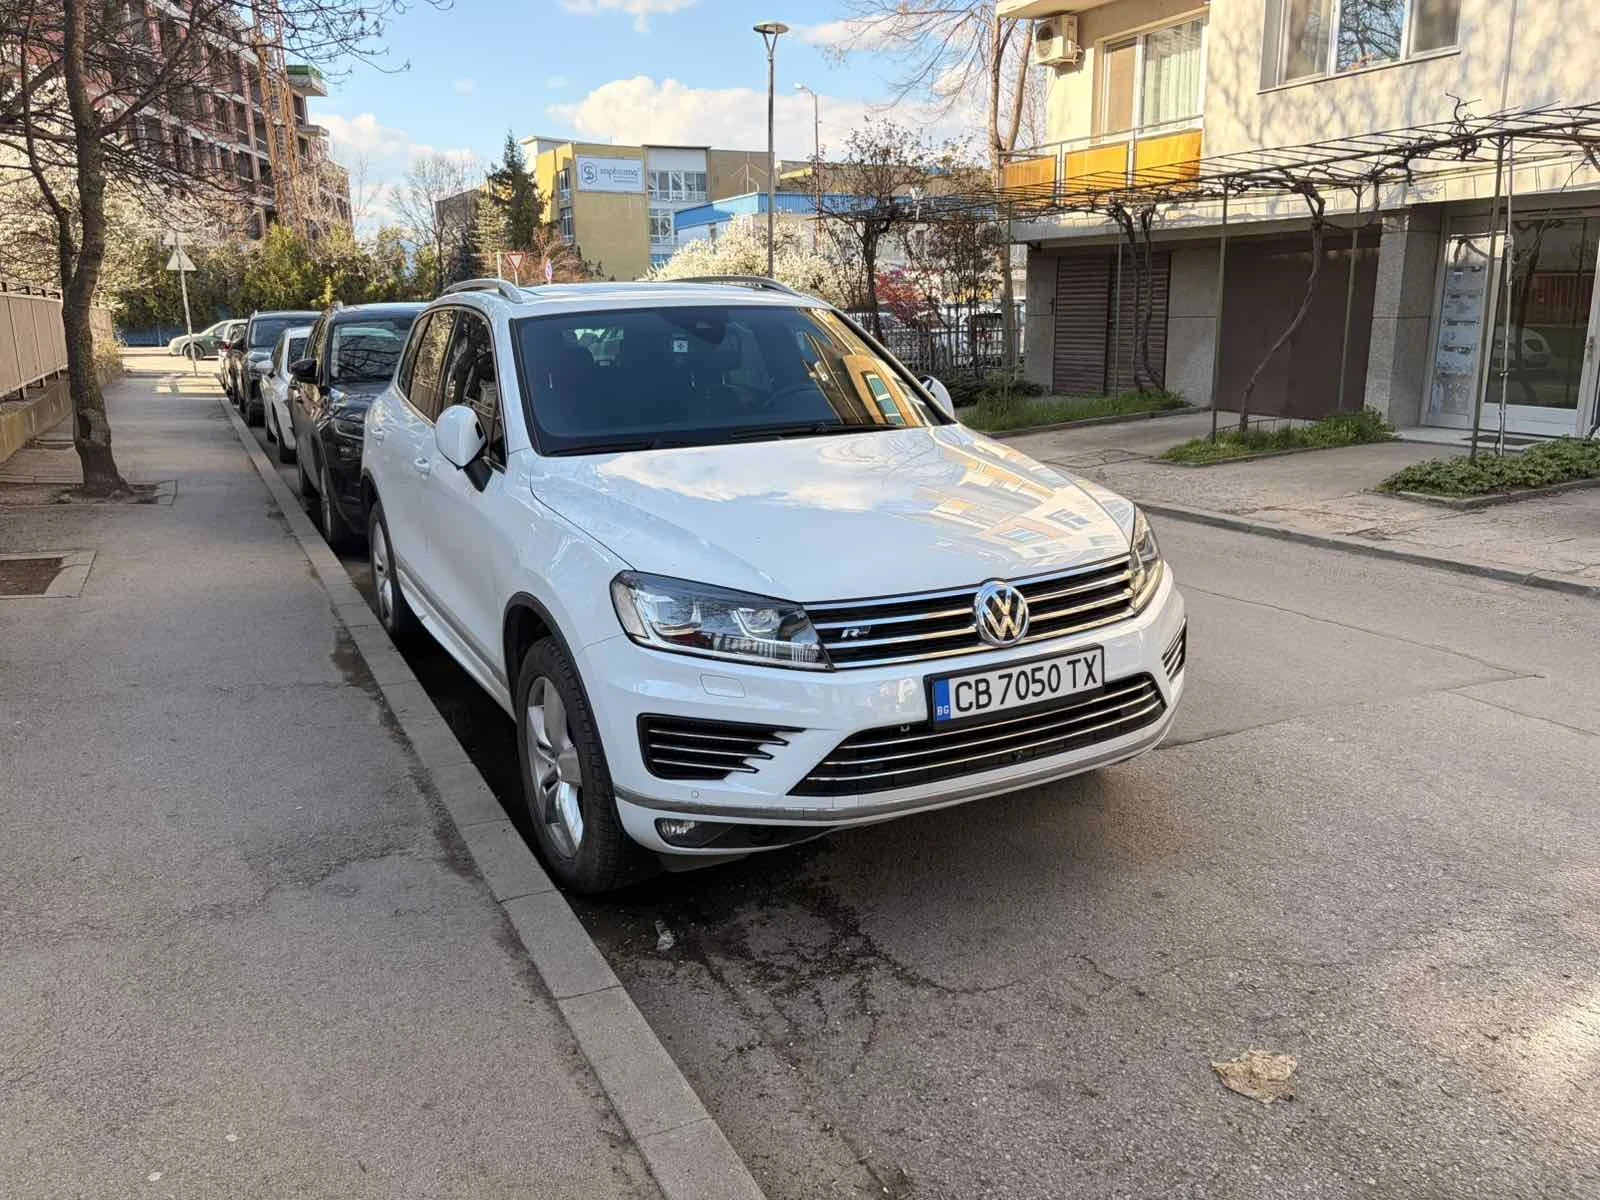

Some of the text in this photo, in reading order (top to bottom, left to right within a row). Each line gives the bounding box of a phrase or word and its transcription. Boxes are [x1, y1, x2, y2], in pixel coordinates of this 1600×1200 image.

[955, 654, 1098, 712] CB 7050 TX
[936, 705, 950, 716] BG
